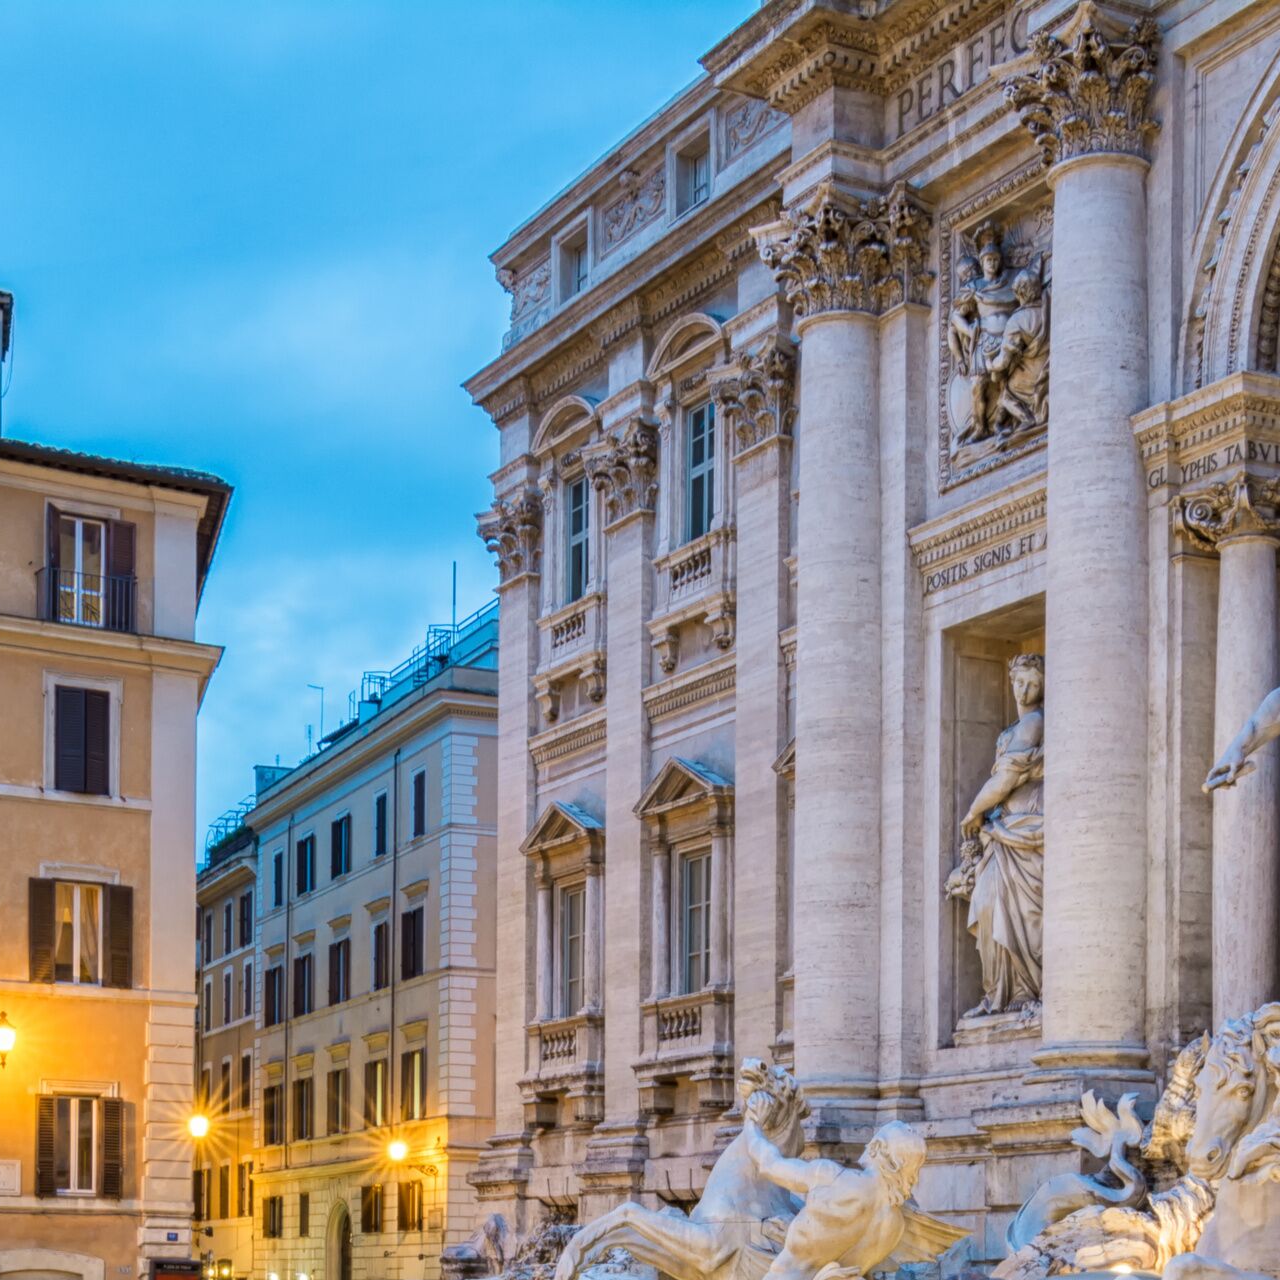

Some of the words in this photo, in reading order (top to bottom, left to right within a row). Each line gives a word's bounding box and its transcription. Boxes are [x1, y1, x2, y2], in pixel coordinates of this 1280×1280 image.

[925, 562, 968, 596] POSITIS
[974, 543, 1011, 574] SIGNIS
[1019, 533, 1036, 556] ET
